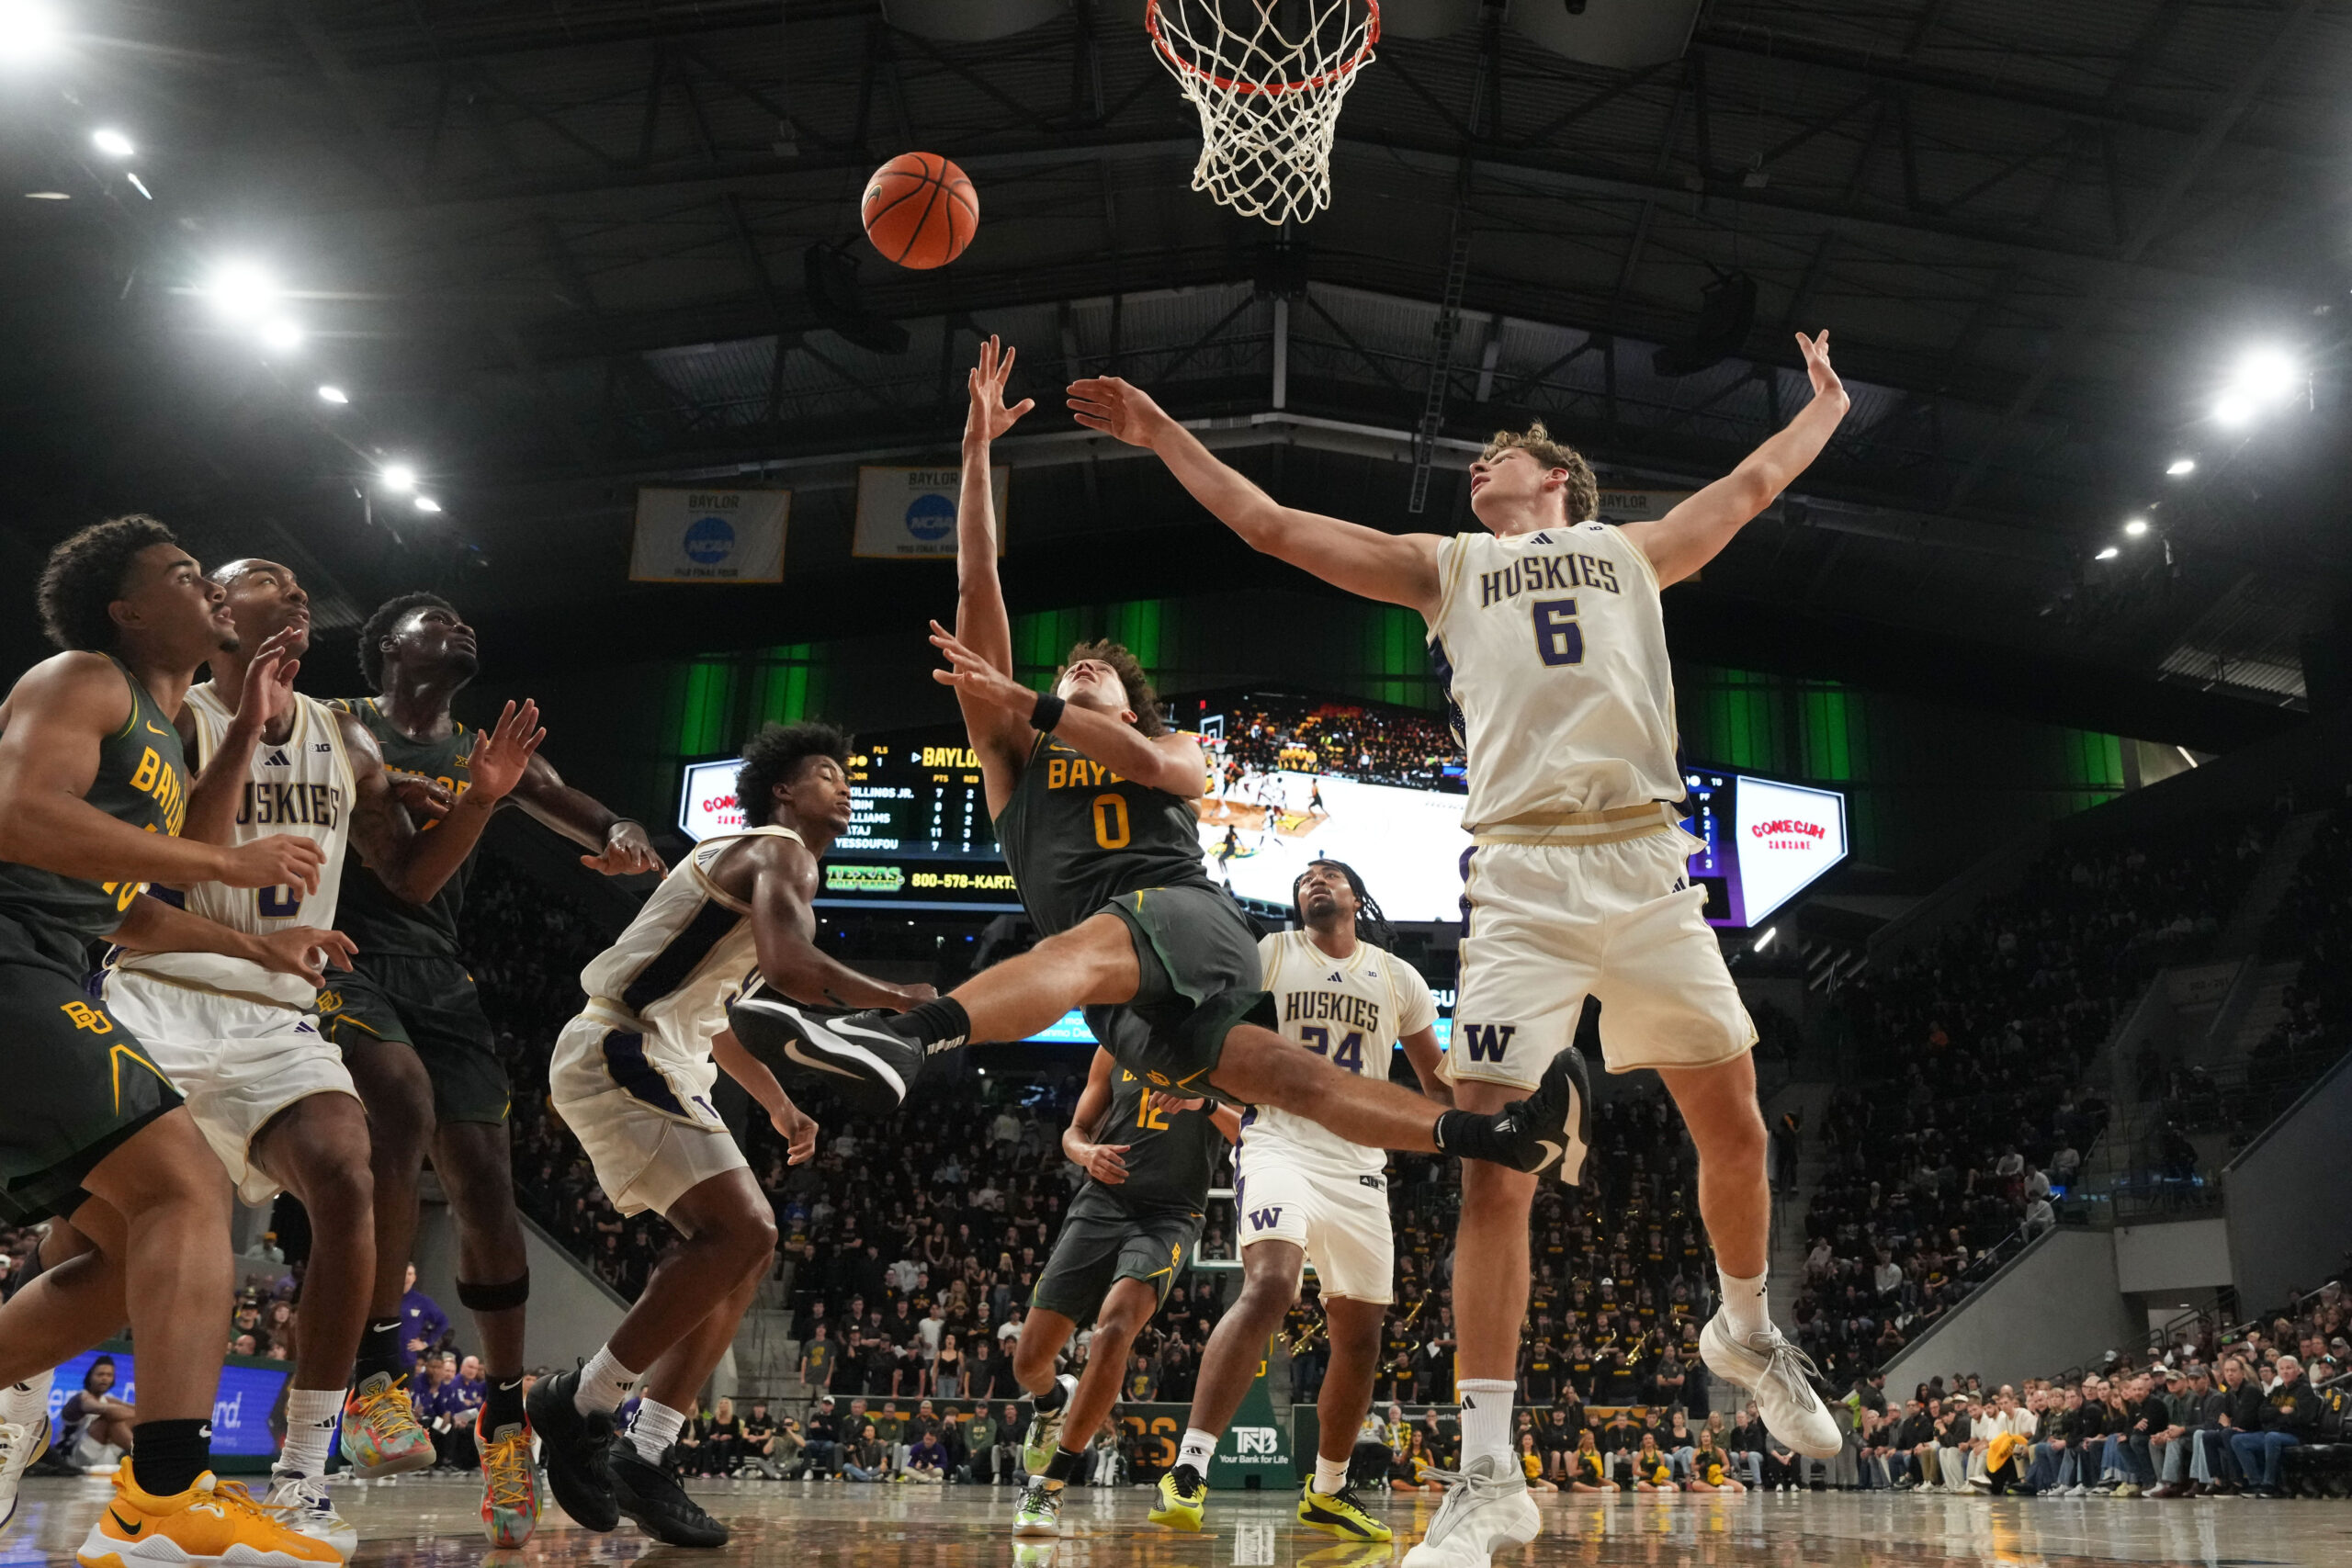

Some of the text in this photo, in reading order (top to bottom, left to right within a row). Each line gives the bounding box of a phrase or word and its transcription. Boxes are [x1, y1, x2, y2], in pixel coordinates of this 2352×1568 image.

[908, 472, 958, 486] BAYLOR
[689, 494, 740, 509] BAYLOR
[1480, 552, 1622, 610] HUSKIES
[1531, 597, 1586, 669] 6
[873, 746, 888, 754] FLS
[876, 757, 883, 767] 1
[922, 747, 982, 768] BAYLO
[933, 774, 979, 784] PTS REB
[130, 745, 184, 838] BAYLO
[849, 787, 974, 799] KILLINGS JR. 7 2
[934, 802, 943, 812] 0
[1702, 807, 1711, 817] 3
[848, 812, 972, 826] LLIAMS 6 2
[1092, 793, 1131, 850] 0
[1703, 820, 1711, 830] 2
[930, 827, 942, 838] 11
[963, 828, 971, 839] 3
[835, 838, 899, 850] YESSOUFOU
[932, 840, 940, 852] 7
[962, 841, 970, 852] 2
[1705, 859, 1713, 869] 3
[60, 1000, 113, 1034] BU
[1285, 990, 1379, 1034] HUSKIES
[1300, 1025, 1364, 1073] 24
[1464, 1023, 1516, 1063] W
[1248, 1207, 1283, 1232] W
[211, 1391, 243, 1429] rd.
[1219, 1454, 1289, 1464] Your Bank for Life
